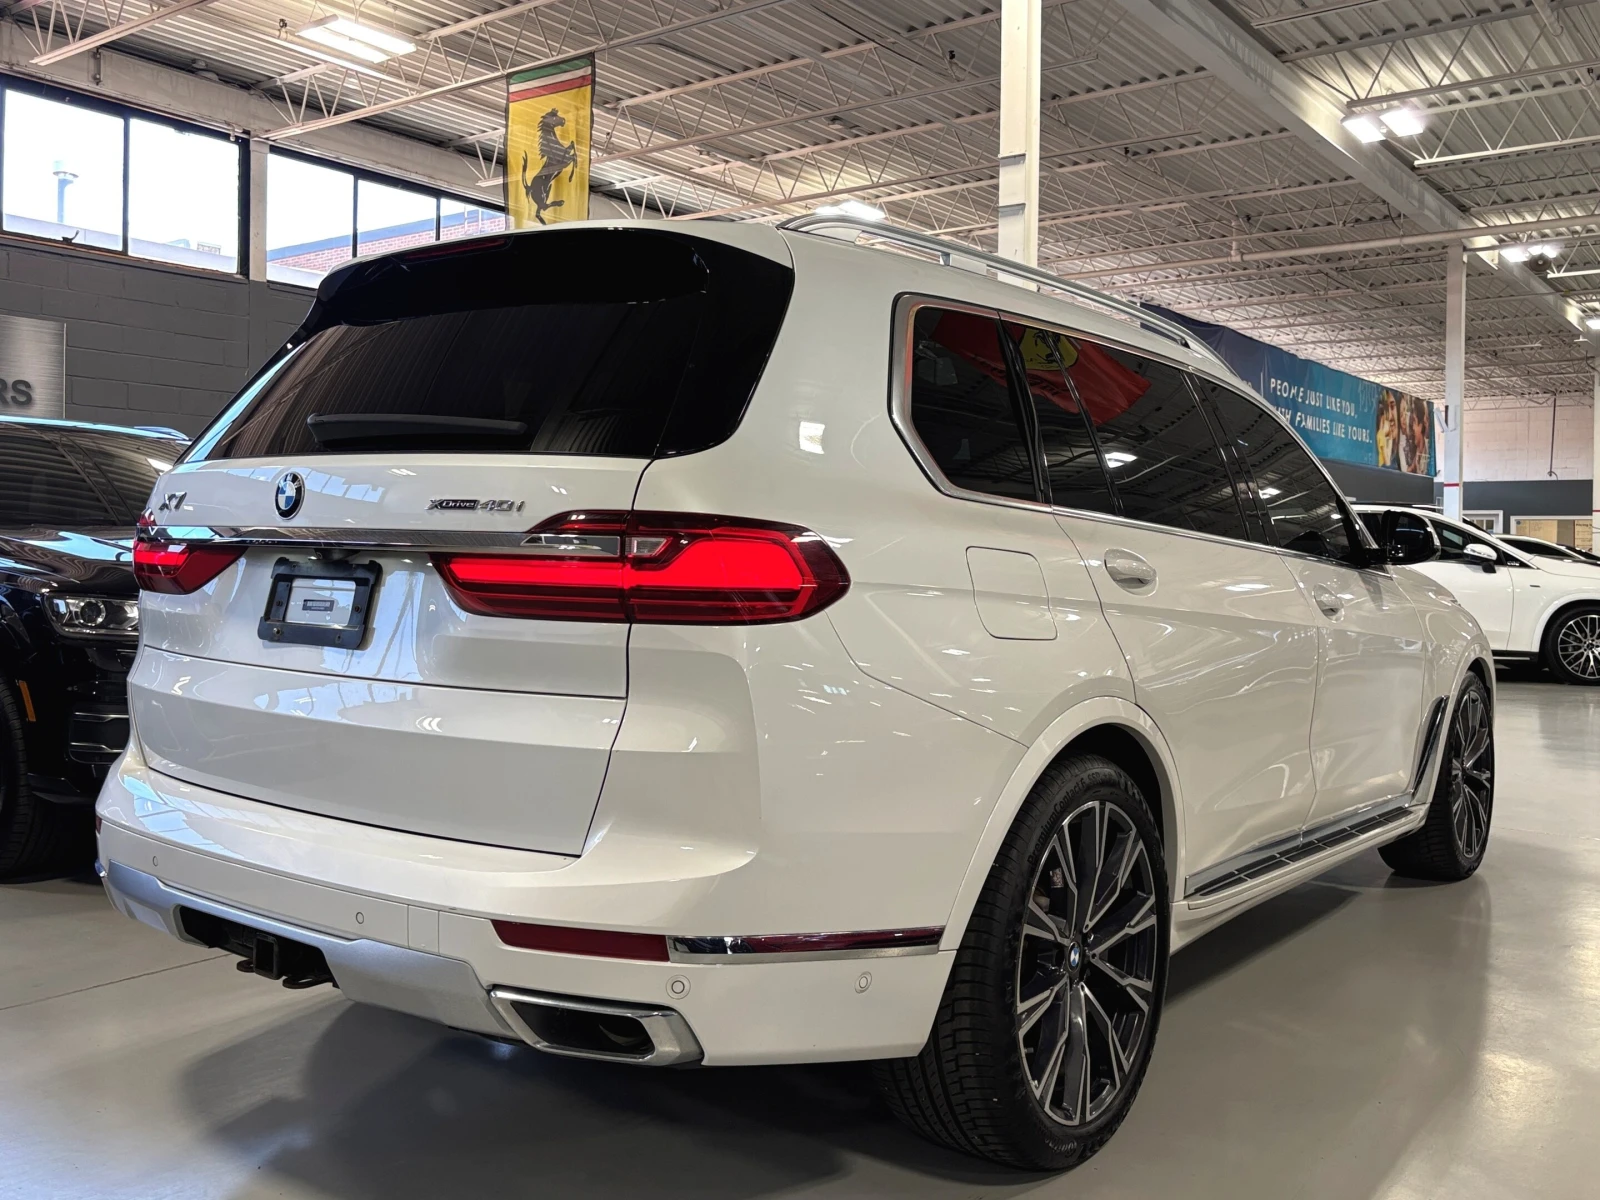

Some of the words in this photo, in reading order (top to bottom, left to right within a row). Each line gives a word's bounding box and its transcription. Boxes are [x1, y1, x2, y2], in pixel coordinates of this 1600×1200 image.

[1305, 389, 1324, 406] JUST
[1326, 395, 1341, 413] LIKE
[1342, 401, 1358, 419] YOU,
[1295, 412, 1331, 434] FAMILIES
[1332, 422, 1346, 437] LIKE
[1347, 426, 1373, 443] YOURS.
[158, 491, 188, 511] X7
